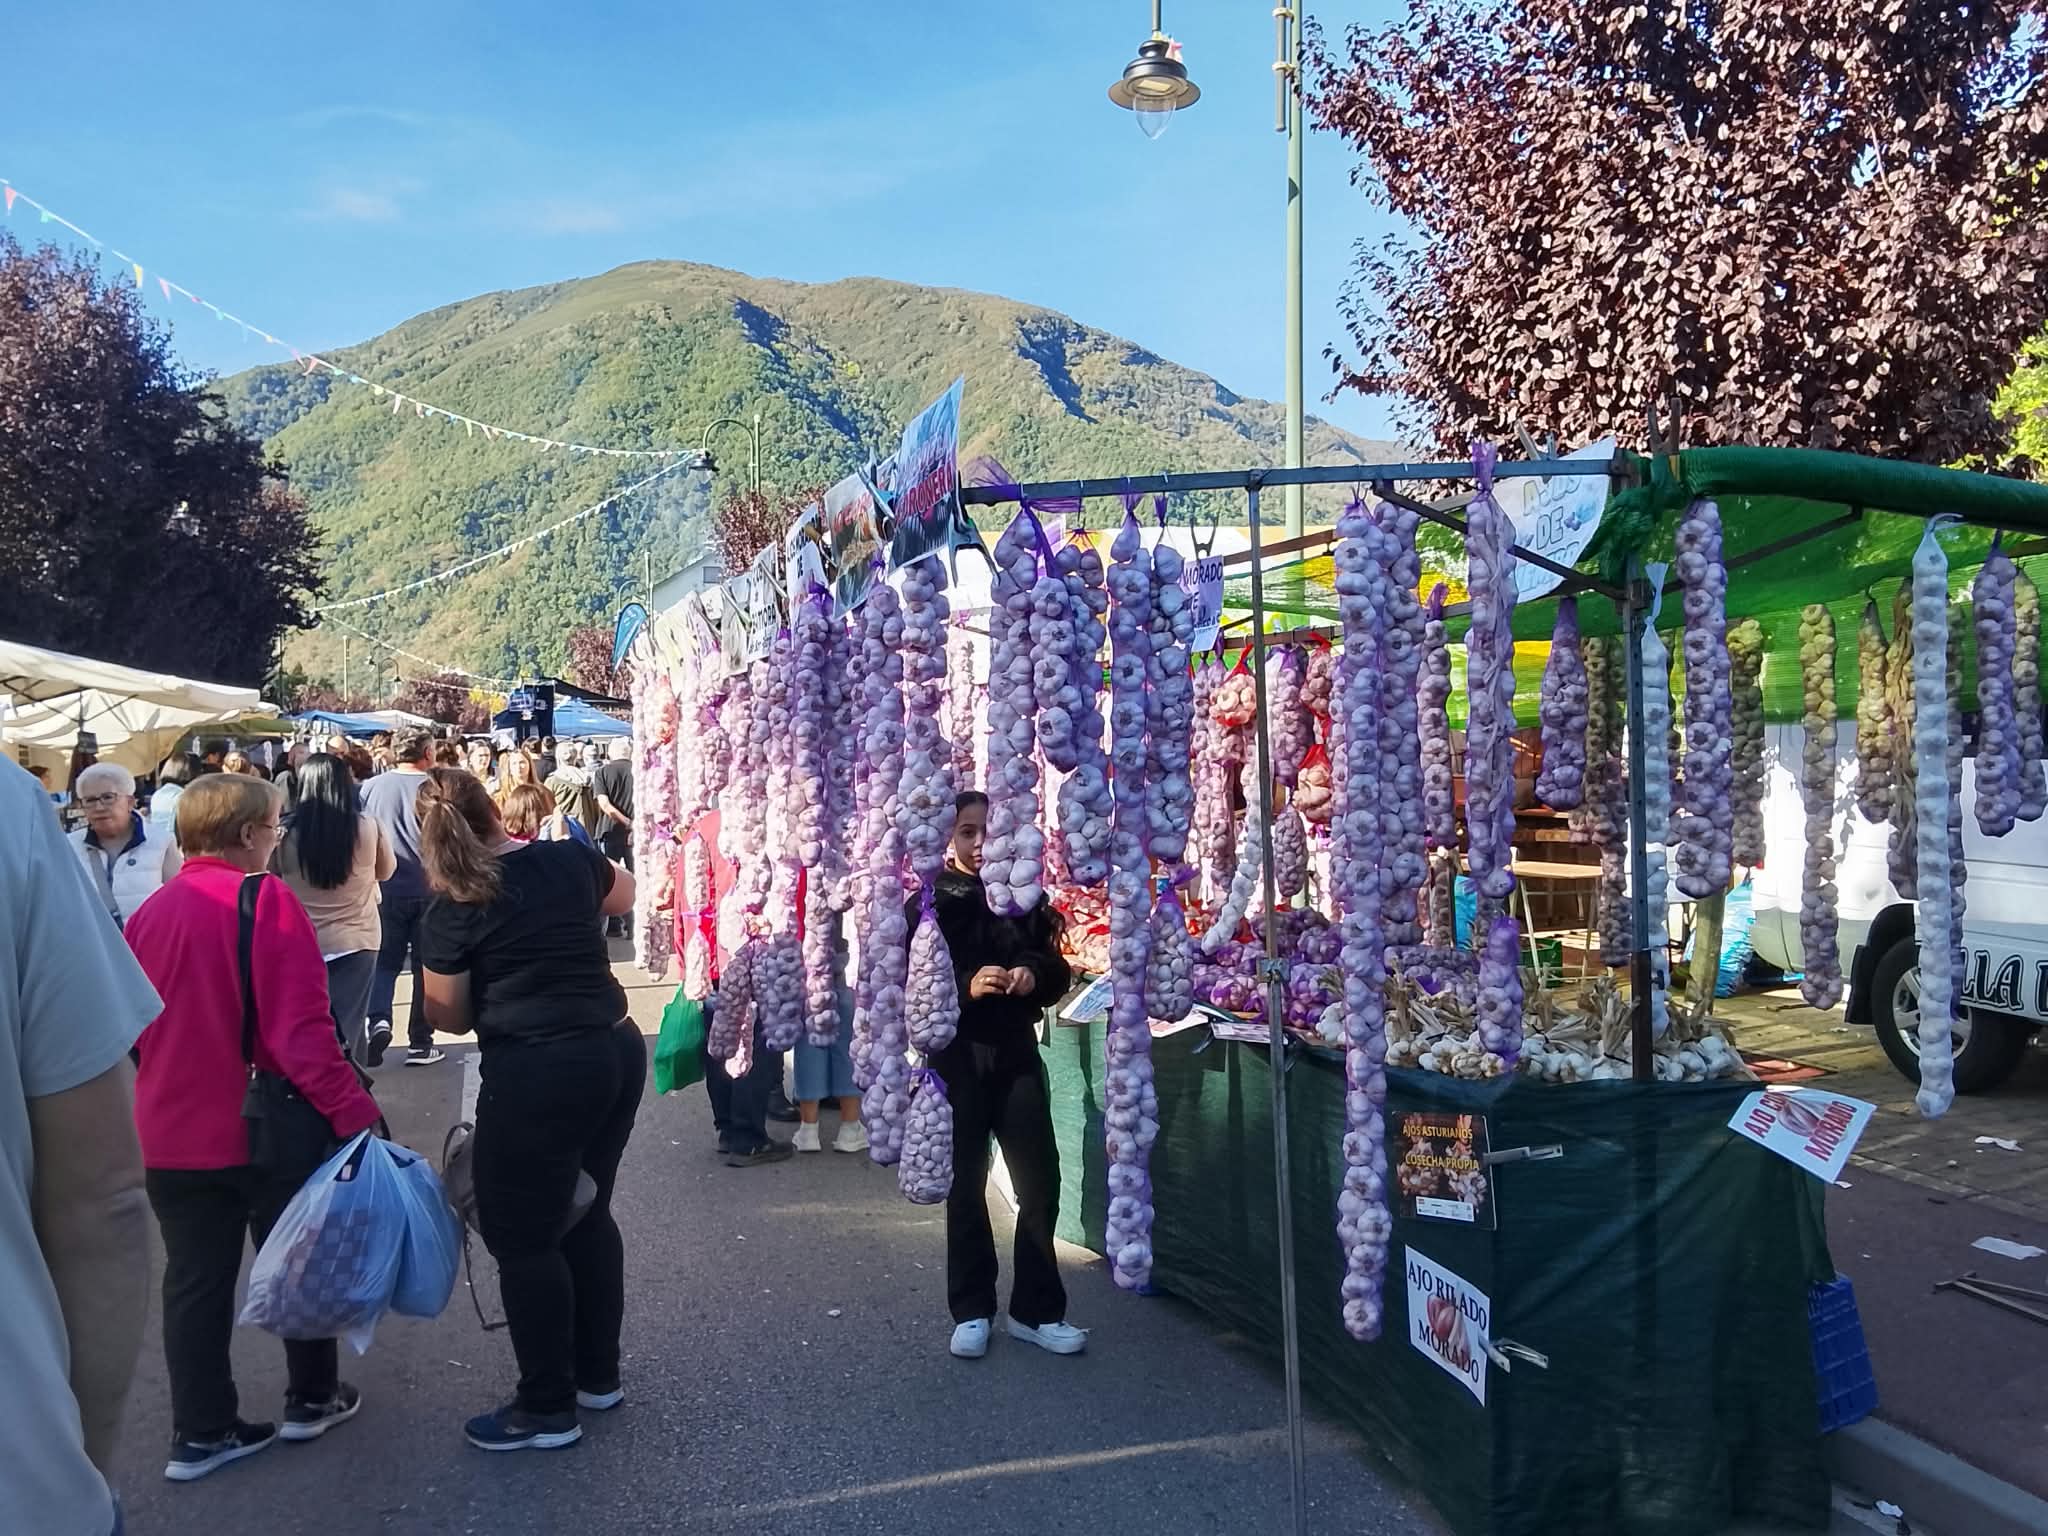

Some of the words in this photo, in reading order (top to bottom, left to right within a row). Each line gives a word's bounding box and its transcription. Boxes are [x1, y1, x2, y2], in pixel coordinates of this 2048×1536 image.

[1536, 506, 1564, 550] DE
[1403, 1125, 1420, 1137] AJOS
[1422, 1126, 1473, 1139] ASTURIANOS
[1744, 1108, 1776, 1139] AJO
[1804, 1101, 1857, 1162] MORADO
[1405, 1154, 1446, 1167] COSECHA
[1446, 1158, 1480, 1170] PROPIA
[1408, 1261, 1433, 1292] AJO
[1435, 1276, 1487, 1331] RILADO
[1418, 1319, 1480, 1383] MORADO
